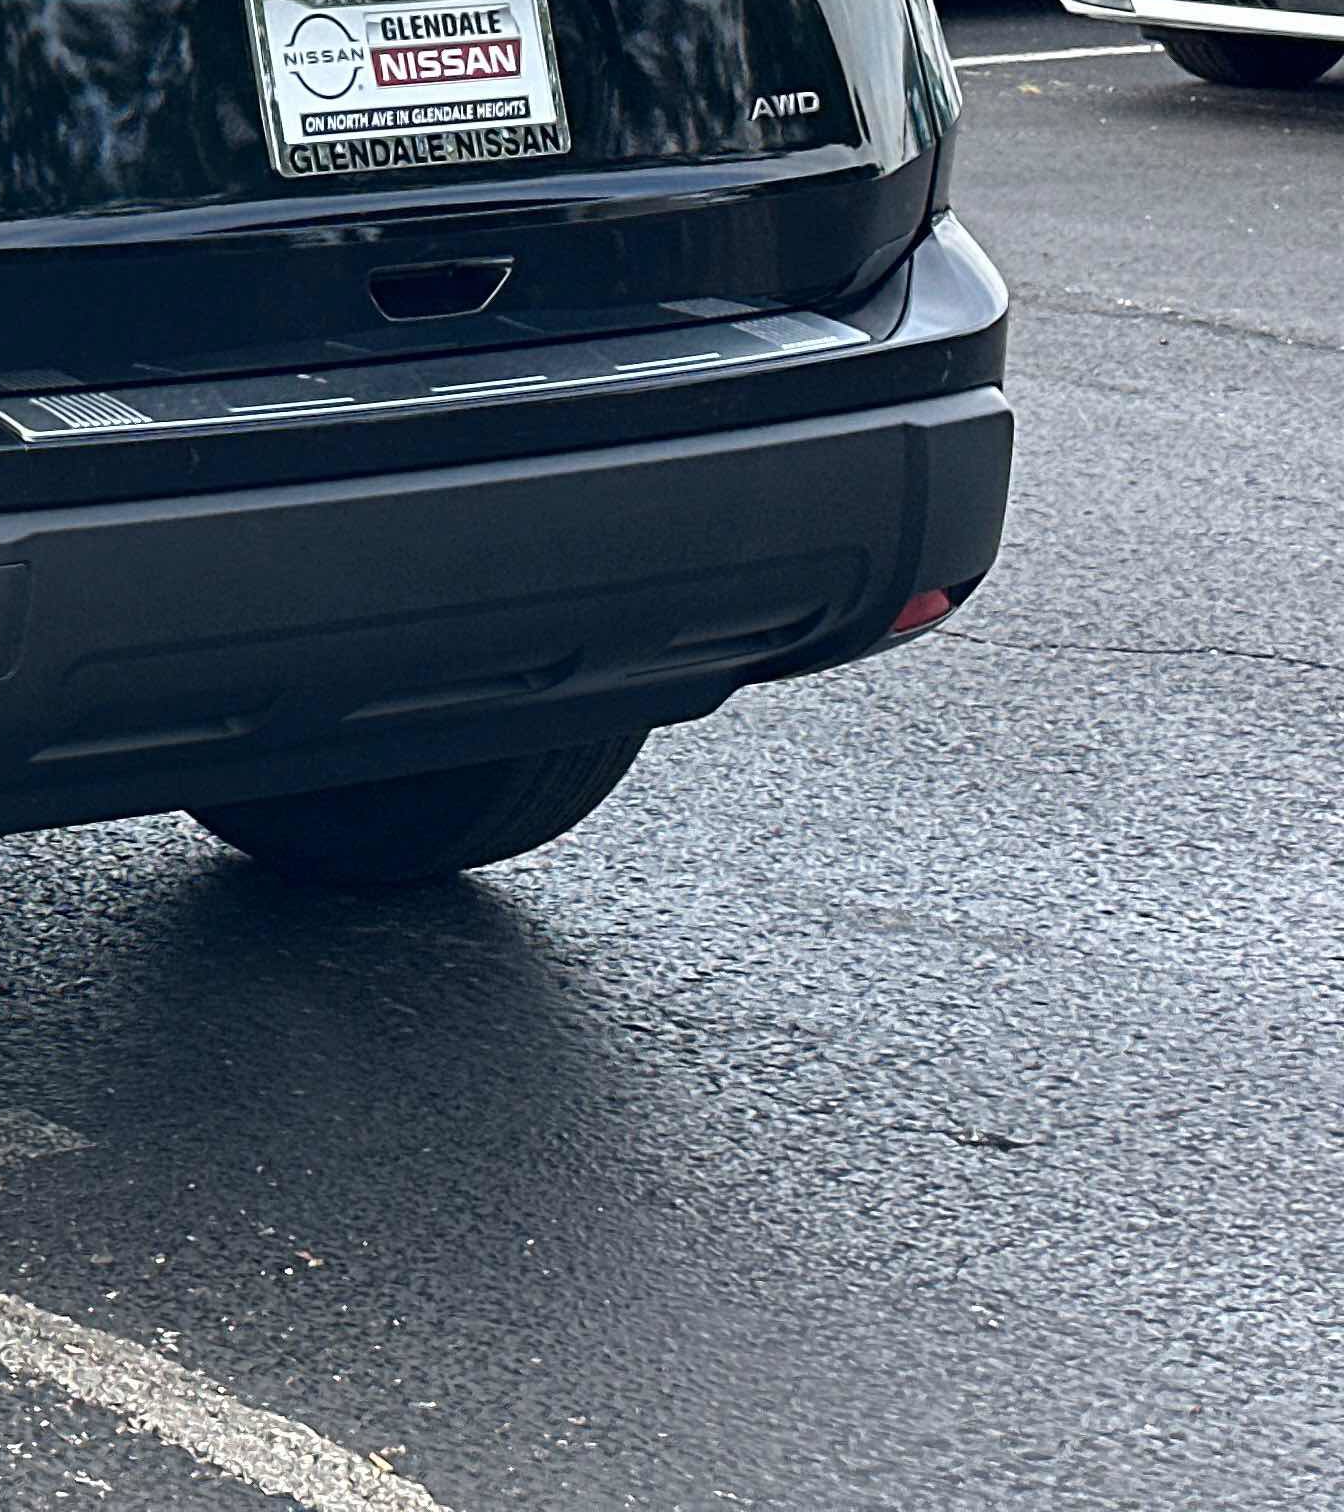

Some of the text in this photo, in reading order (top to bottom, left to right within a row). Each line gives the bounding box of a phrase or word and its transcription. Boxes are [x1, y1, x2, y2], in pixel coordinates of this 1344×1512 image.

[380, 9, 503, 41] GLENDALE
[283, 47, 365, 67] NISSAN
[379, 44, 517, 81] NISSAN
[305, 99, 527, 133] ON NORTH AVE IN GLENDALE HEIGHTS
[751, 91, 821, 121] AWD
[288, 124, 561, 175] GLENDALE NISSAN
